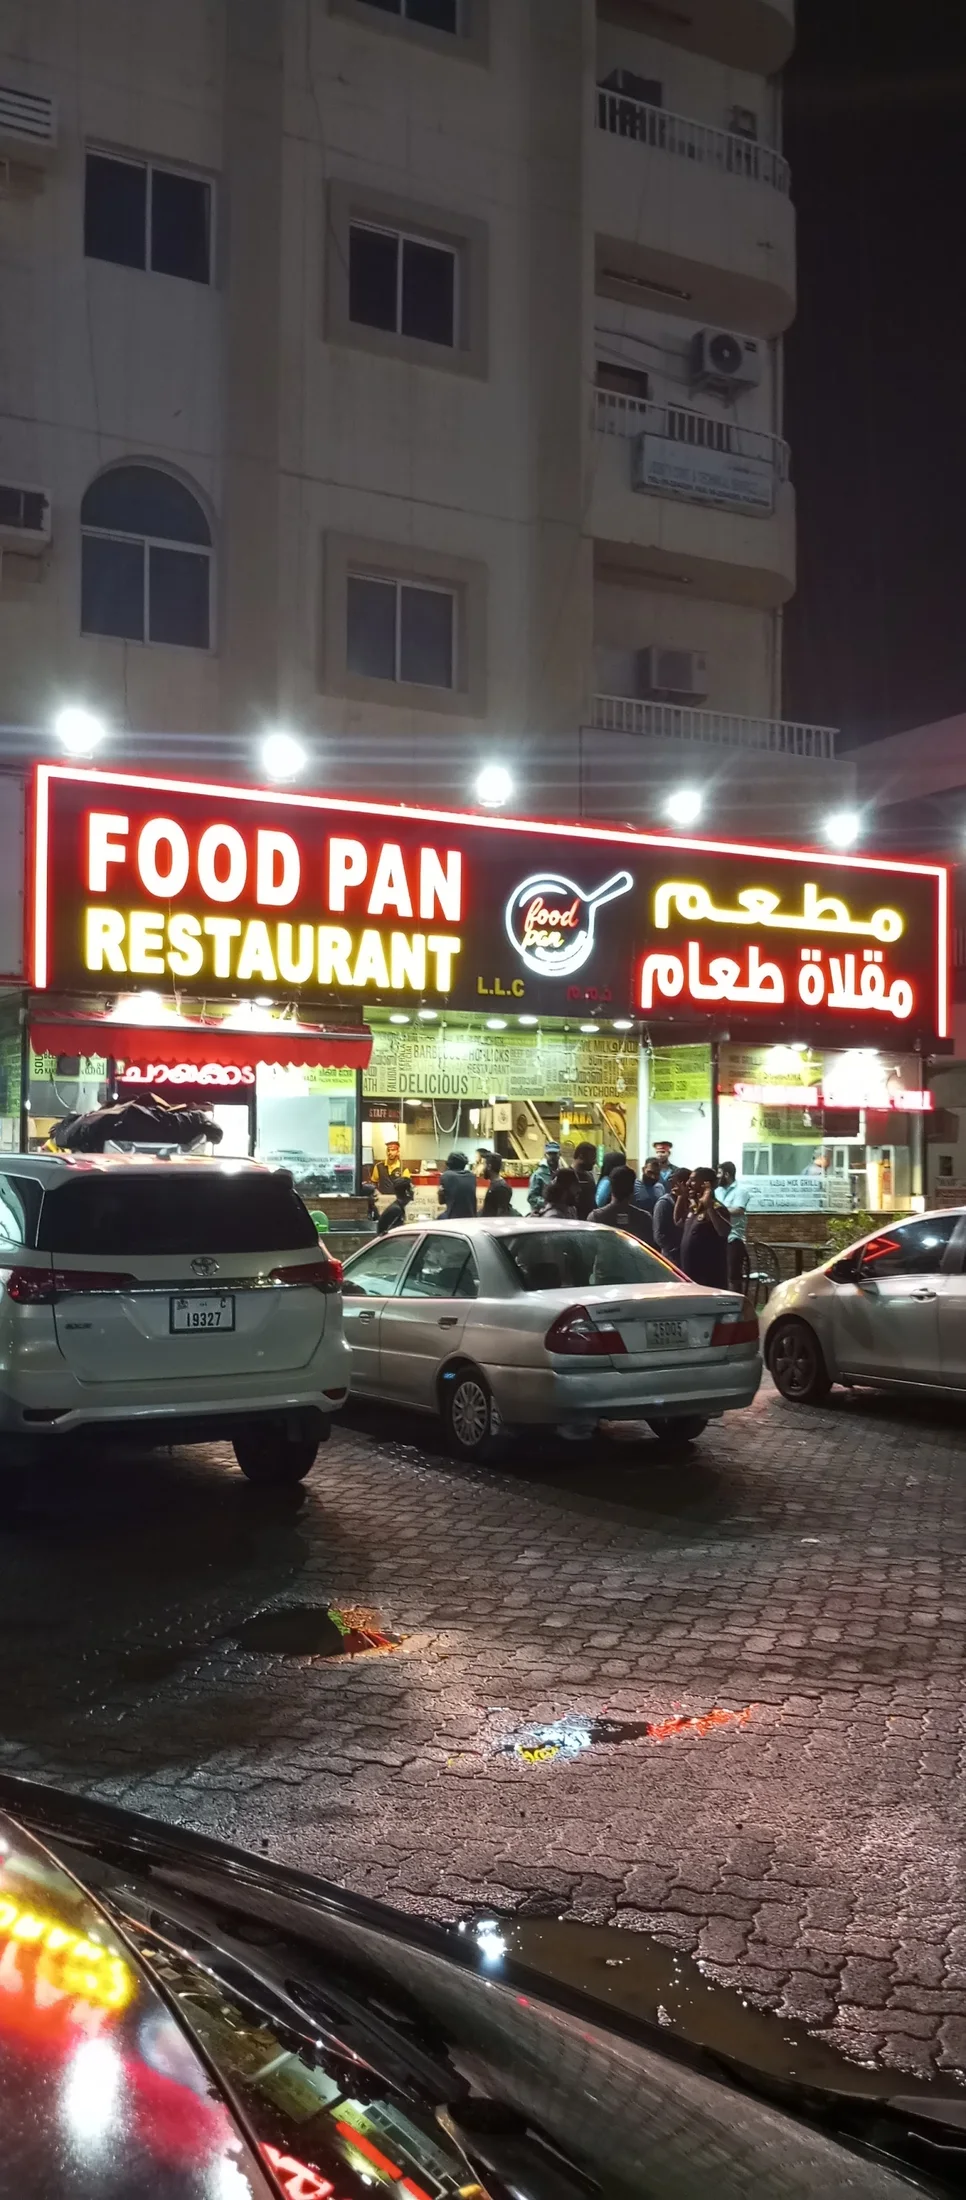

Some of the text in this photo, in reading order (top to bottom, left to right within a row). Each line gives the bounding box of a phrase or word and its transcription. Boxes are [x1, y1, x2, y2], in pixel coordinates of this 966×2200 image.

[87, 811, 463, 923] FOOD PAN
[524, 897, 580, 932] food
[654, 882, 904, 943] مطعم
[85, 907, 462, 993] RESTAURANT
[477, 976, 525, 998] L.L.C
[640, 941, 914, 1019] مقلاة طعام
[399, 1073, 468, 1094] DELICIOUS
[470, 1076, 503, 1095] TATY
[187, 1311, 222, 1327] 19327
